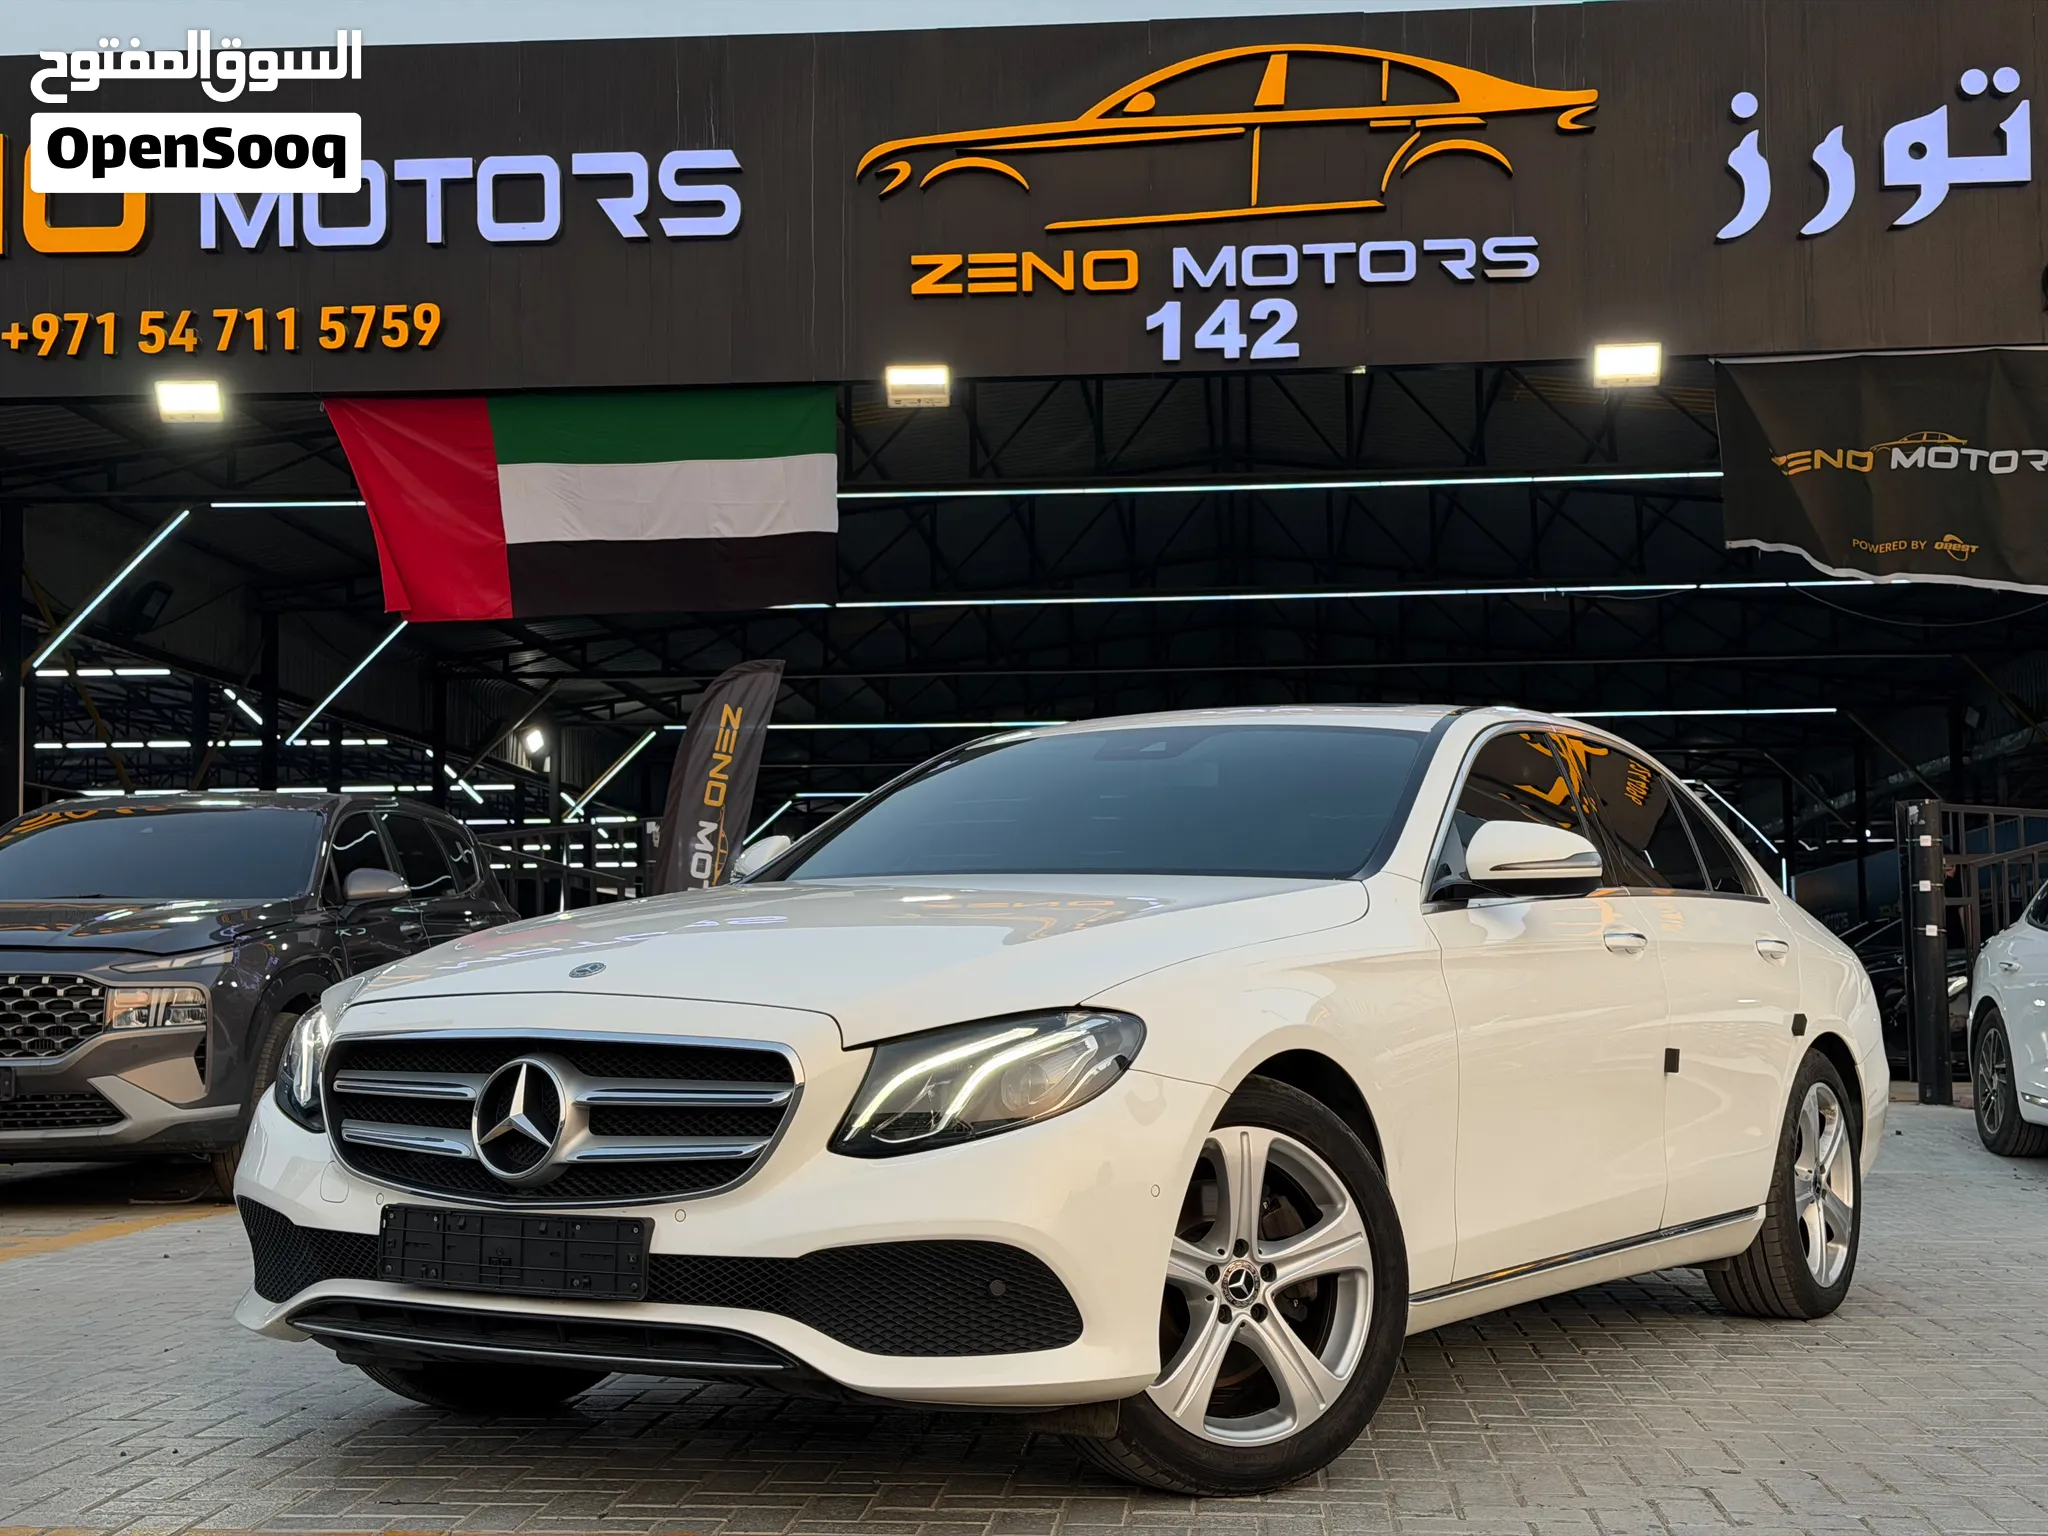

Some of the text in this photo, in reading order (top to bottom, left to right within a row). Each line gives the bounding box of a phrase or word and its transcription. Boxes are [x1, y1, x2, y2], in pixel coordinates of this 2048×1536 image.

[910, 235, 1540, 295] ZENO MOTORS
[1, 303, 441, 356] +971 54 711 5759
[1146, 298, 1300, 361] 142
[1852, 538, 1907, 554] POWERED
[1911, 540, 1927, 550] BY
[703, 703, 743, 808] ZENO
